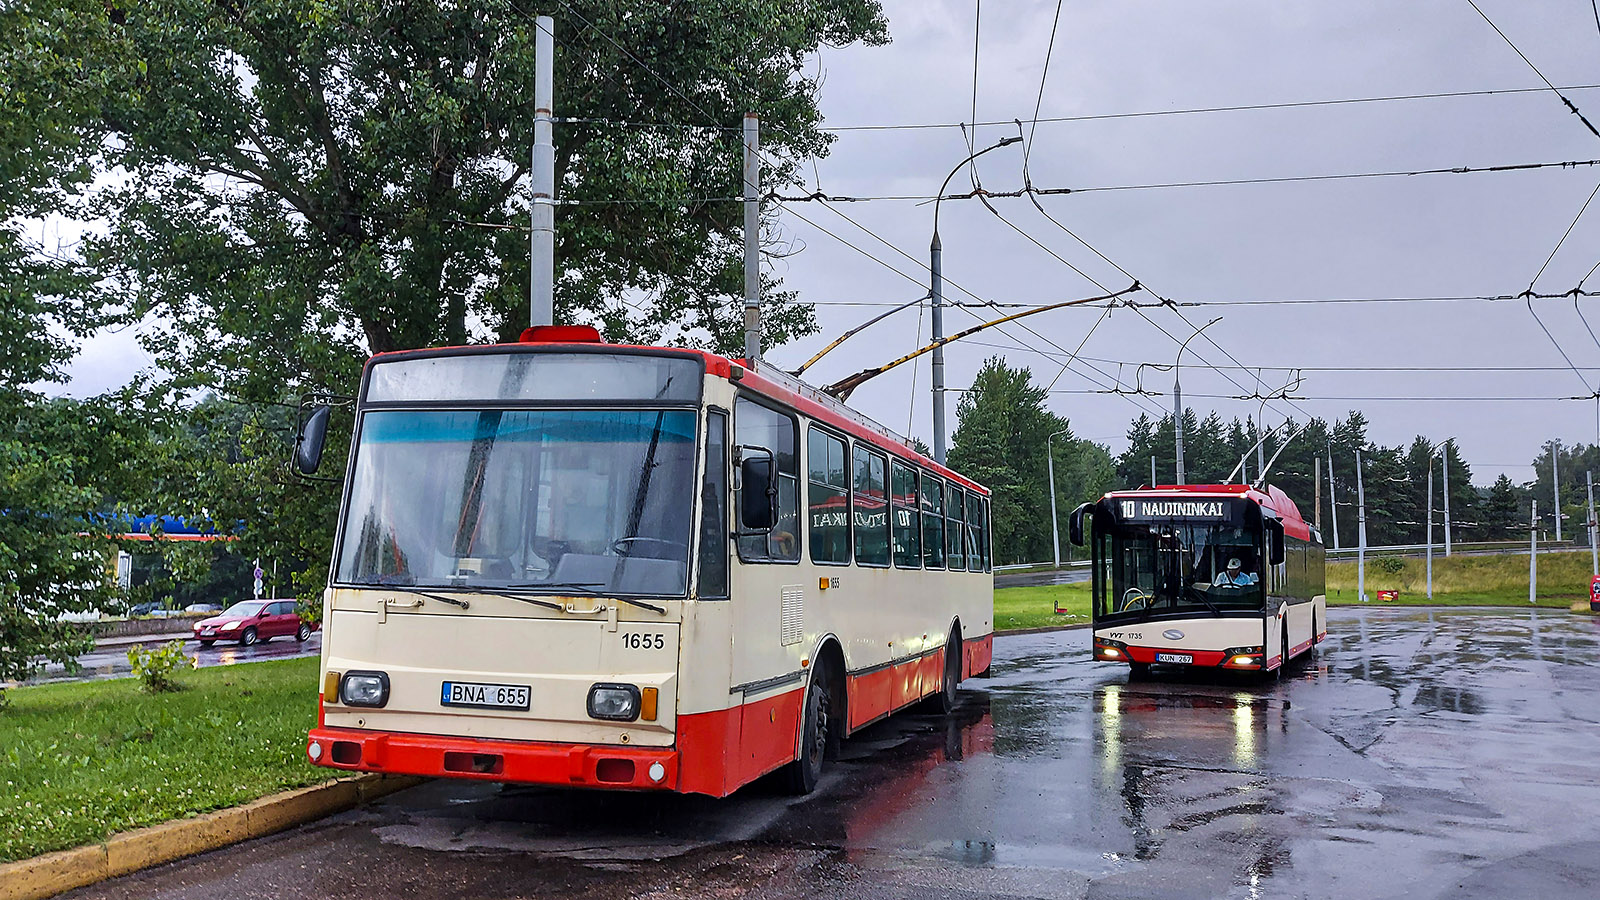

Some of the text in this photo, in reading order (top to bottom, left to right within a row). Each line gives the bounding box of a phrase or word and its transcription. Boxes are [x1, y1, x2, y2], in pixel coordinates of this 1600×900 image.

[1121, 501, 1223, 518] 10 NAUJININKAI
[830, 577, 840, 589] 1655
[621, 633, 664, 650] 1655
[1128, 632, 1143, 640] 1735
[452, 685, 526, 704] BNA 655
